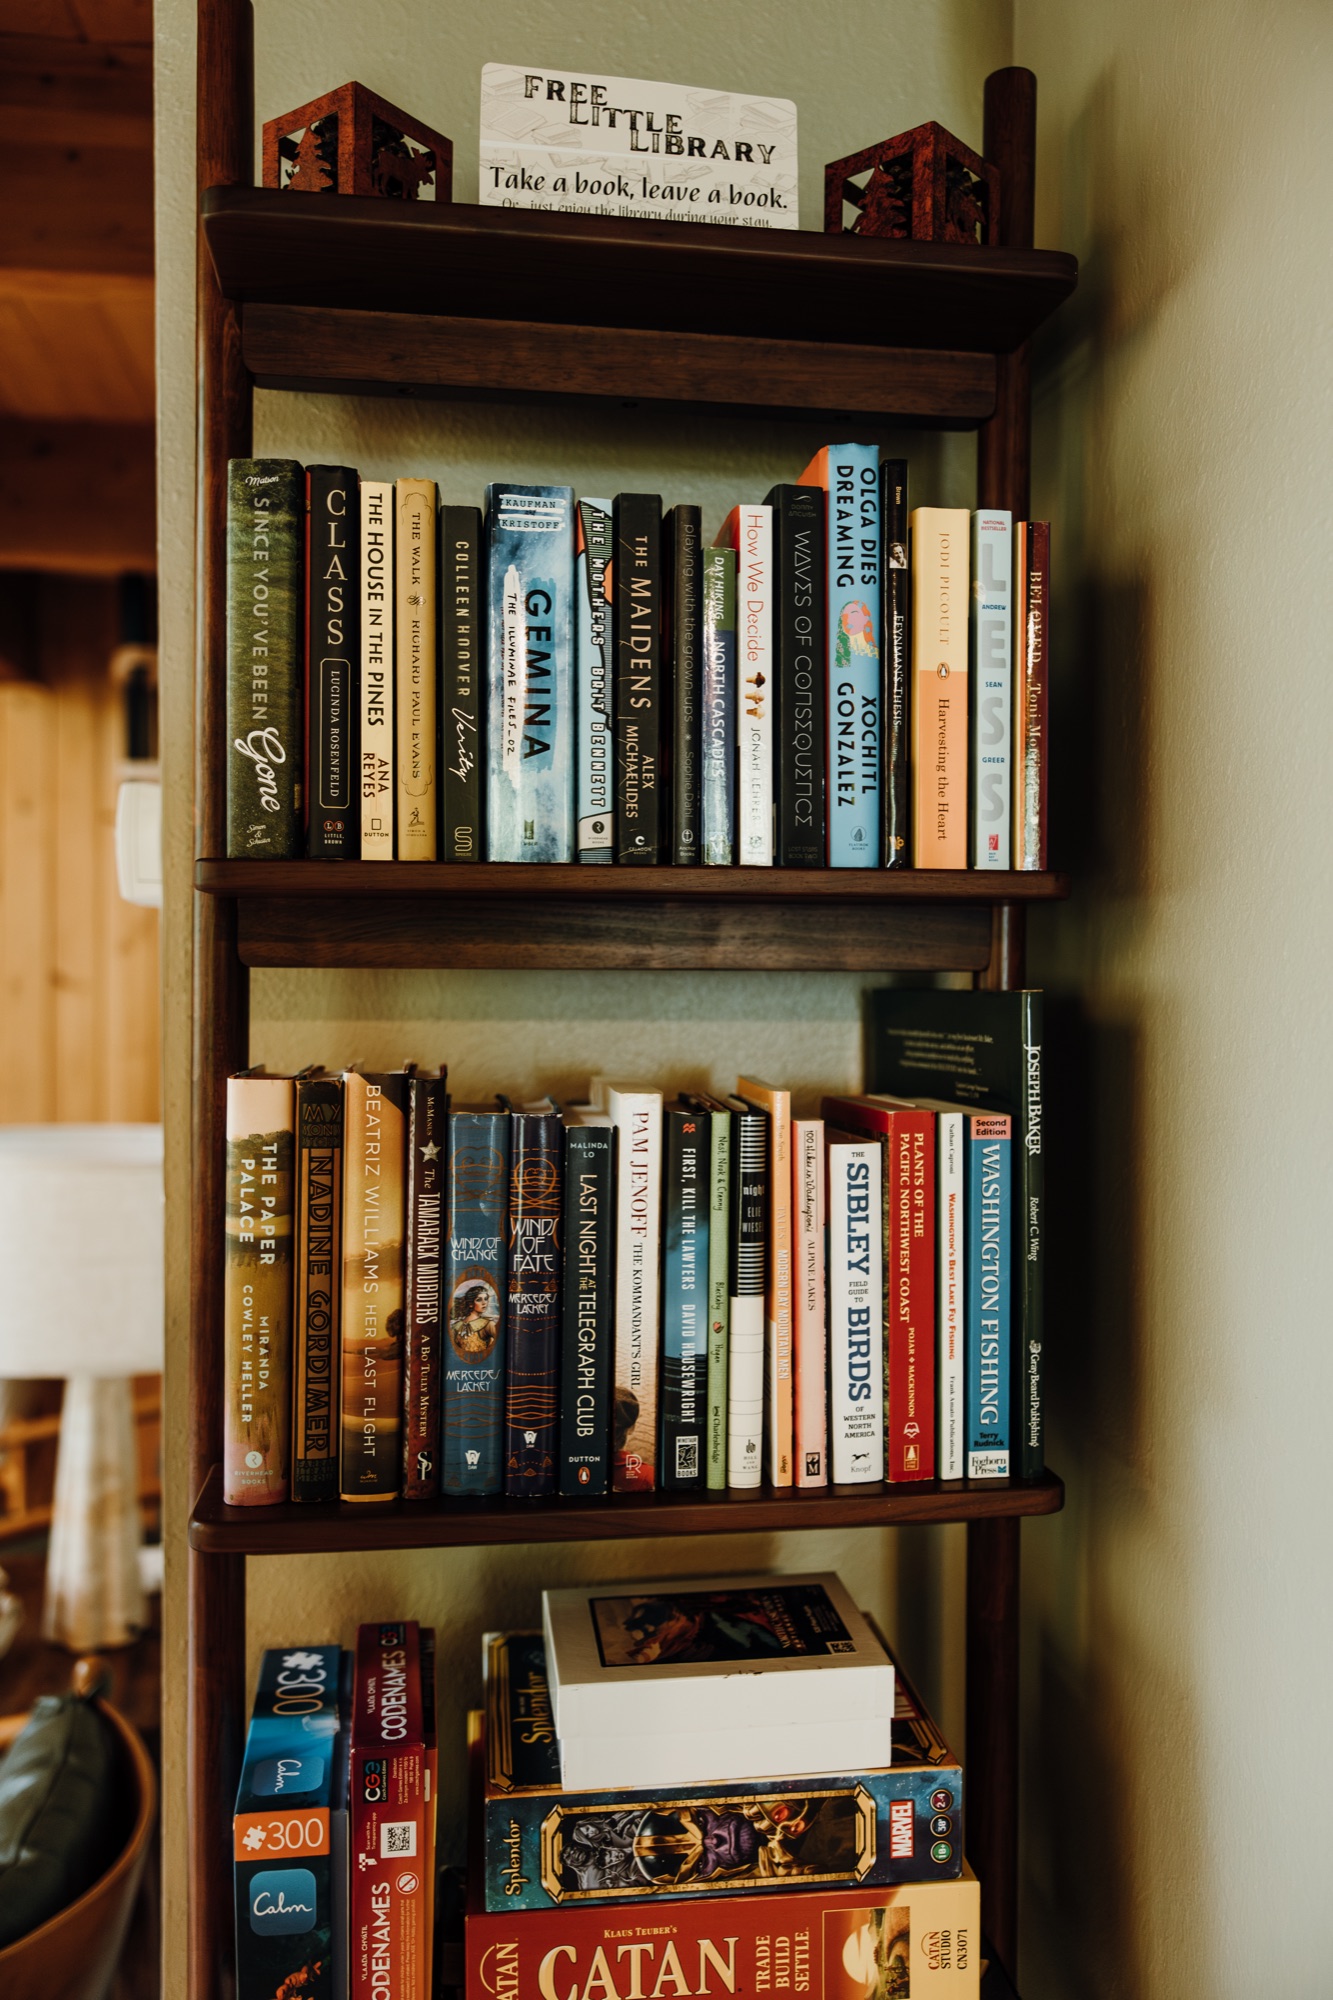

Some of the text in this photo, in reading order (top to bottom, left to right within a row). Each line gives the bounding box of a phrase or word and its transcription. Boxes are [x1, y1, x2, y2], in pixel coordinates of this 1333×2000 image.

[525, 75, 608, 106] FREE
[569, 102, 683, 135] LITTLE
[630, 130, 776, 164] LIBRARY
[490, 166, 788, 209] Take a book, leave a book.
[245, 476, 279, 486] Matson
[505, 499, 556, 508] KAUFMAN
[894, 486, 903, 505] Brown
[501, 519, 560, 529] KRISTOFF
[837, 465, 855, 588] DREAMING
[860, 467, 877, 586] OLGA DIES
[323, 489, 348, 645] CLASS
[367, 493, 384, 726] THE HOUSE IN THE PINES
[411, 512, 421, 779] THE WALK RICHARD PAUL EVANS
[629, 536, 652, 709] THE MAIDENS
[234, 498, 286, 812] SINCE YOU'VE BEEN Gone
[449, 541, 477, 782] COLLEEN HOOVER Verity
[523, 589, 552, 760] GEMINA
[591, 511, 606, 808] THE MOTHERS BRIT BENNETT
[682, 524, 696, 818] playing with the grown-ups Sophie Dahl
[711, 556, 726, 777] DAY HIKING NORTH CASCADES
[746, 514, 764, 821] How We Decide JONAH LEHRER
[935, 532, 950, 841] JODI PICOULT Harvesting the Heart
[329, 670, 340, 797] LUCINDA ROSENFELD
[837, 682, 854, 807] GONZALEZ
[861, 694, 877, 795] XOCHITL
[363, 752, 375, 798] REYES
[378, 758, 390, 793] ANA
[626, 725, 639, 818] MICHAELIDES
[641, 754, 655, 790] ALEX
[365, 1085, 382, 1176] BEATRIZ
[976, 1119, 1007, 1127] Second
[976, 1128, 1007, 1136] Edition
[1023, 1044, 1042, 1156] JOSEPH BAKER
[239, 1158, 256, 1243] PALACE
[259, 1143, 278, 1266] THE PAPER
[308, 1154, 330, 1275] NADINE
[847, 1163, 870, 1275] SIBLEY
[914, 1133, 924, 1238] PLANTS OF THE
[363, 1186, 380, 1293] WILLIAMS
[415, 1168, 439, 1324] The TAMARACK MURDERS
[629, 1111, 649, 1389] PAM JENOFF THE KOMMANDANT'S GIRL
[900, 1133, 910, 1323] PACIFIC NORTHWEST COAST
[1027, 1197, 1040, 1261] Robert C. Wing
[364, 1304, 377, 1337] HER
[576, 1174, 597, 1437] LAST NIGHT AT THE TELEGRAPH CLUB
[679, 1148, 696, 1423] FIRST, KILL THE LAWYERS DAVID HOUSEWRIGHT
[979, 1144, 1001, 1425] WASHINGTON FISHING
[241, 1285, 254, 1423] COWLEY HELLER
[258, 1316, 270, 1390] MIRANDA
[306, 1289, 330, 1454] GORDIMER
[363, 1346, 377, 1388] LAST
[848, 1306, 871, 1402] BIRDS
[907, 1327, 916, 1418] POJAR MACKINNON
[362, 1396, 376, 1456] FLIGHT
[568, 1455, 600, 1463] DUTTON
[844, 1430, 875, 1439] AMERICA
[847, 1422, 872, 1430] NORTH
[971, 1456, 1007, 1467] Foghorn
[973, 1438, 1005, 1447] Rudnick
[979, 1432, 999, 1440] Terry
[850, 1464, 872, 1473] Knopf
[974, 1465, 998, 1475] Press
[272, 1668, 327, 1715] 300
[381, 1650, 407, 1741] CODENAMES
[274, 1759, 302, 1792] Calm
[267, 1818, 324, 1851] 300
[501, 1818, 530, 1897] Splendor
[892, 1801, 913, 1858] MARVEL
[253, 1891, 313, 1916] Calm
[603, 1925, 677, 1939] KLAUS TEUBER'S
[538, 1937, 741, 2000] CATAN
[755, 1935, 771, 1993] TRADE
[775, 1936, 790, 1988] BUILD
[795, 1930, 810, 1992] SETTLE
[928, 1931, 941, 1970] CATAN
[940, 1929, 952, 1969] STUDIO
[956, 1928, 968, 1970] CN3071
